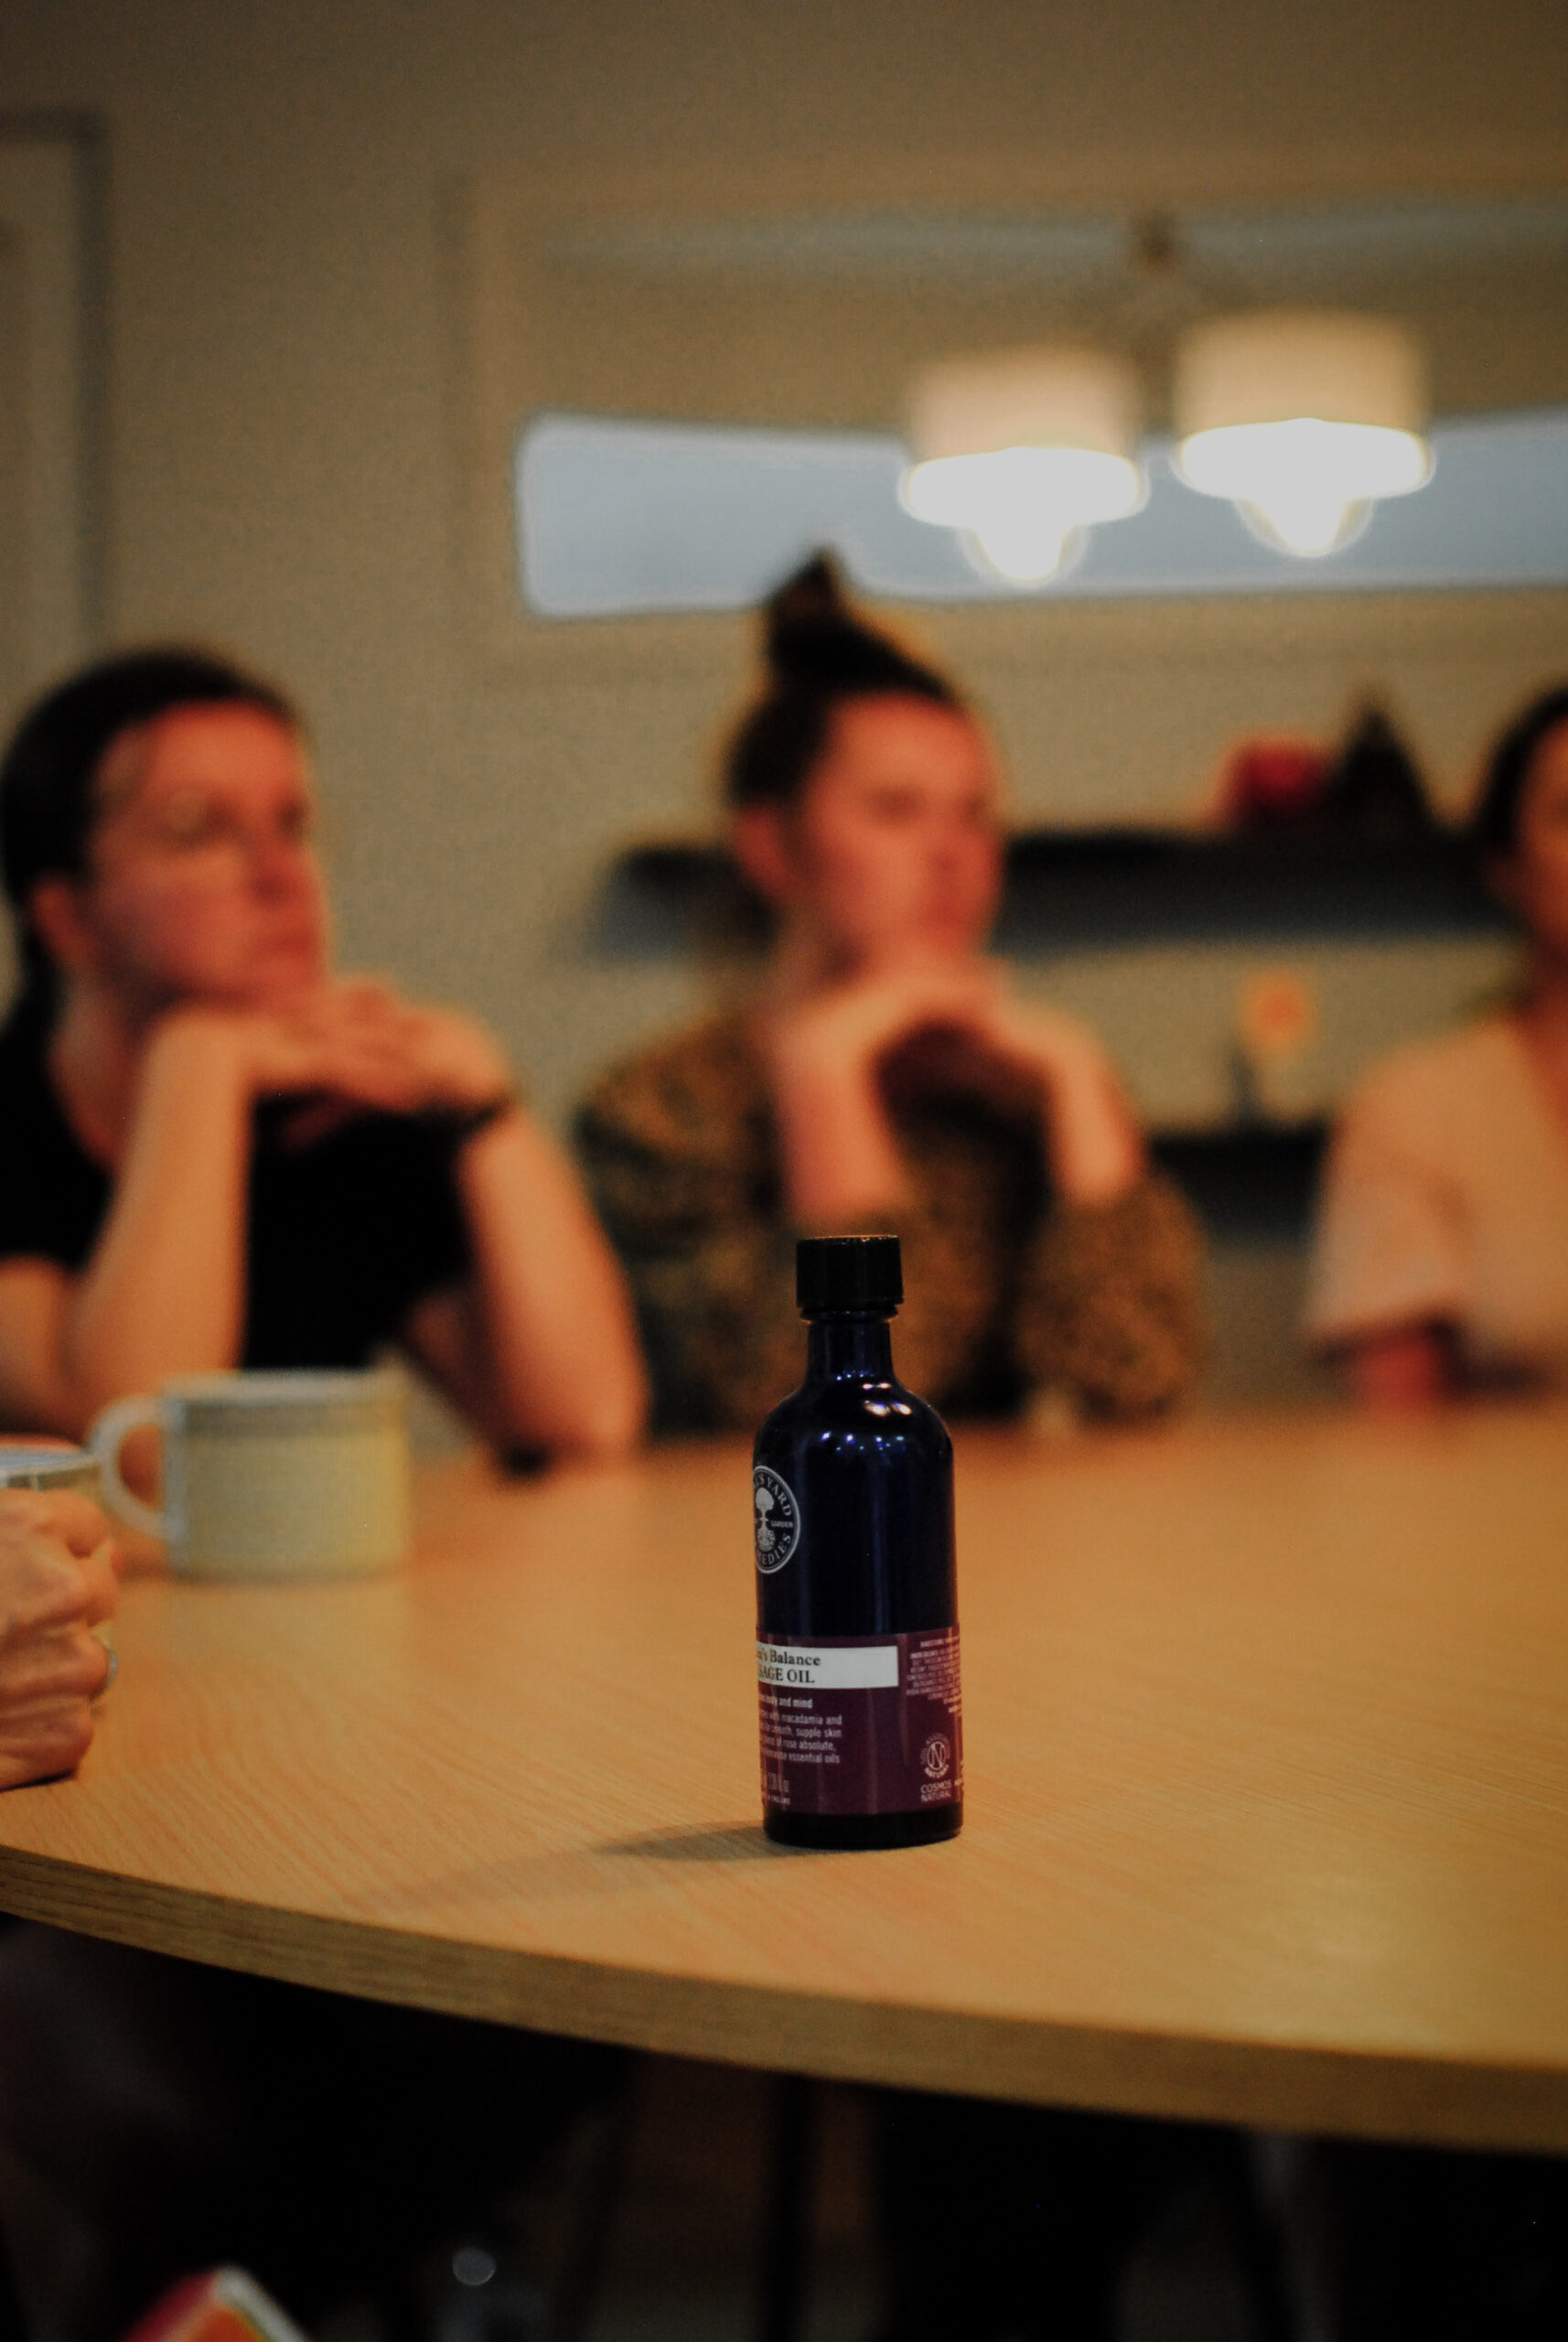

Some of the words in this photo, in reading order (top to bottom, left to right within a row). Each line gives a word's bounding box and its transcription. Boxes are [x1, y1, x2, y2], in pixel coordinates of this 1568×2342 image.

[768, 1477, 792, 1516] YARD
[769, 1649, 821, 1666] Balance
[787, 1669, 815, 1683] OIL
[779, 1697, 791, 1707] and
[792, 1698, 812, 1709] mind
[781, 1714, 823, 1725] macadamia
[826, 1714, 843, 1725] and
[796, 1727, 822, 1738] supple
[824, 1728, 842, 1738] skin
[788, 1752, 822, 1764] essential
[824, 1754, 841, 1764] oils
[920, 1780, 952, 1794] COSMOS
